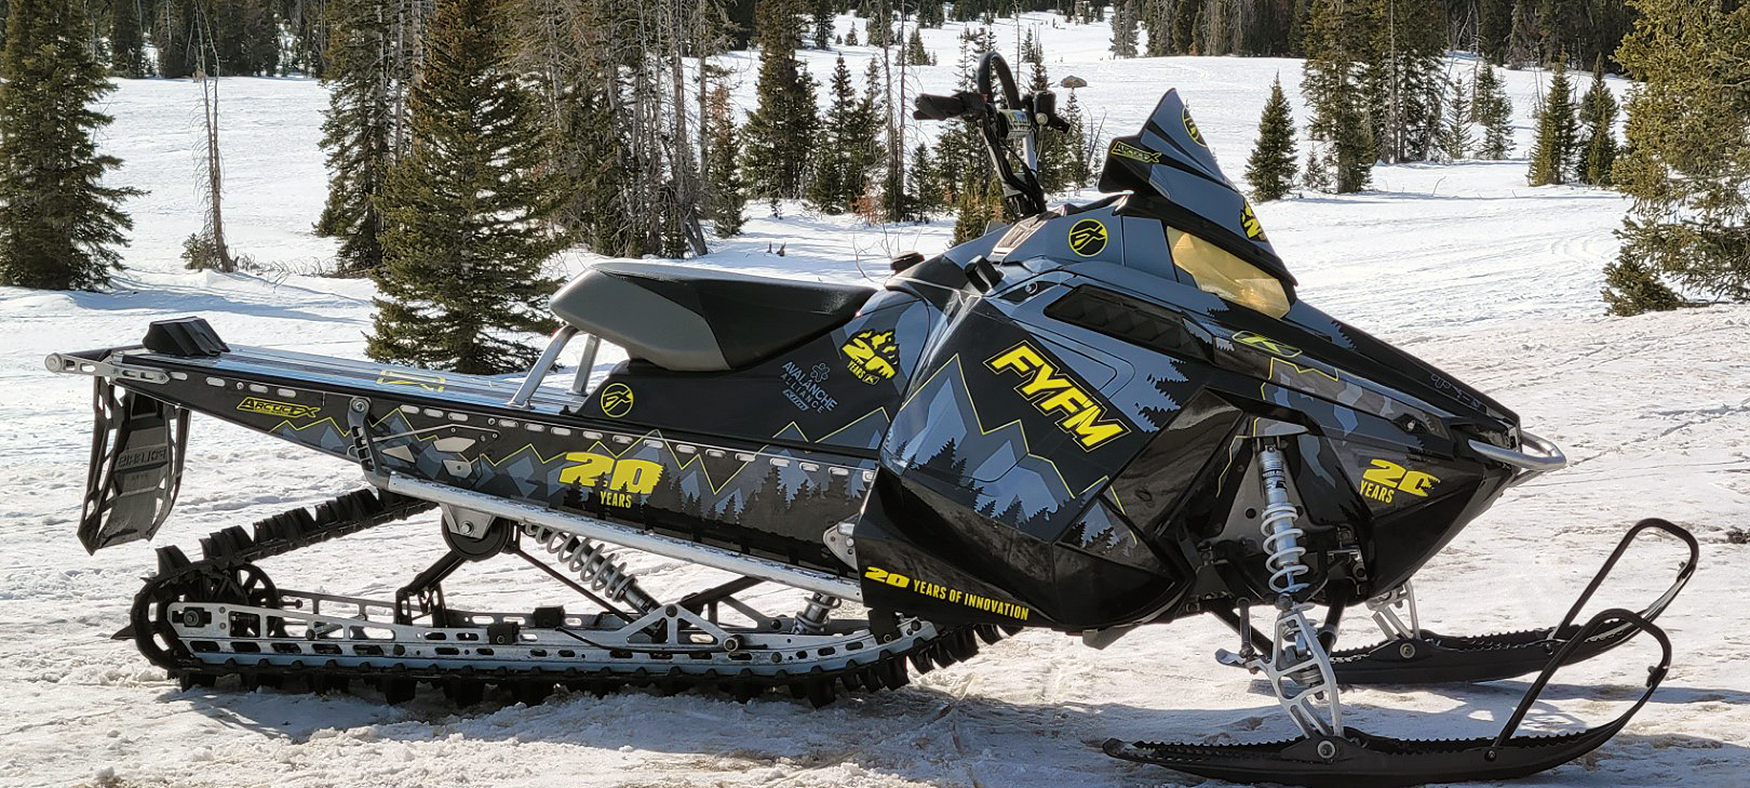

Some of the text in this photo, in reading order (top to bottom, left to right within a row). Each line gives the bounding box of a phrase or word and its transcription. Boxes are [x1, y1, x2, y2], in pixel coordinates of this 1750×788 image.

[781, 361, 838, 411] AVALANCHE
[847, 360, 867, 379] YEARS
[780, 373, 825, 413] ALLIANCE
[991, 345, 1124, 447] FYFM
[559, 452, 664, 494] 20
[1359, 480, 1395, 504] YEARS
[600, 491, 632, 508] YEARS
[864, 566, 1029, 621] 20 YEARS OF INNOVATION
